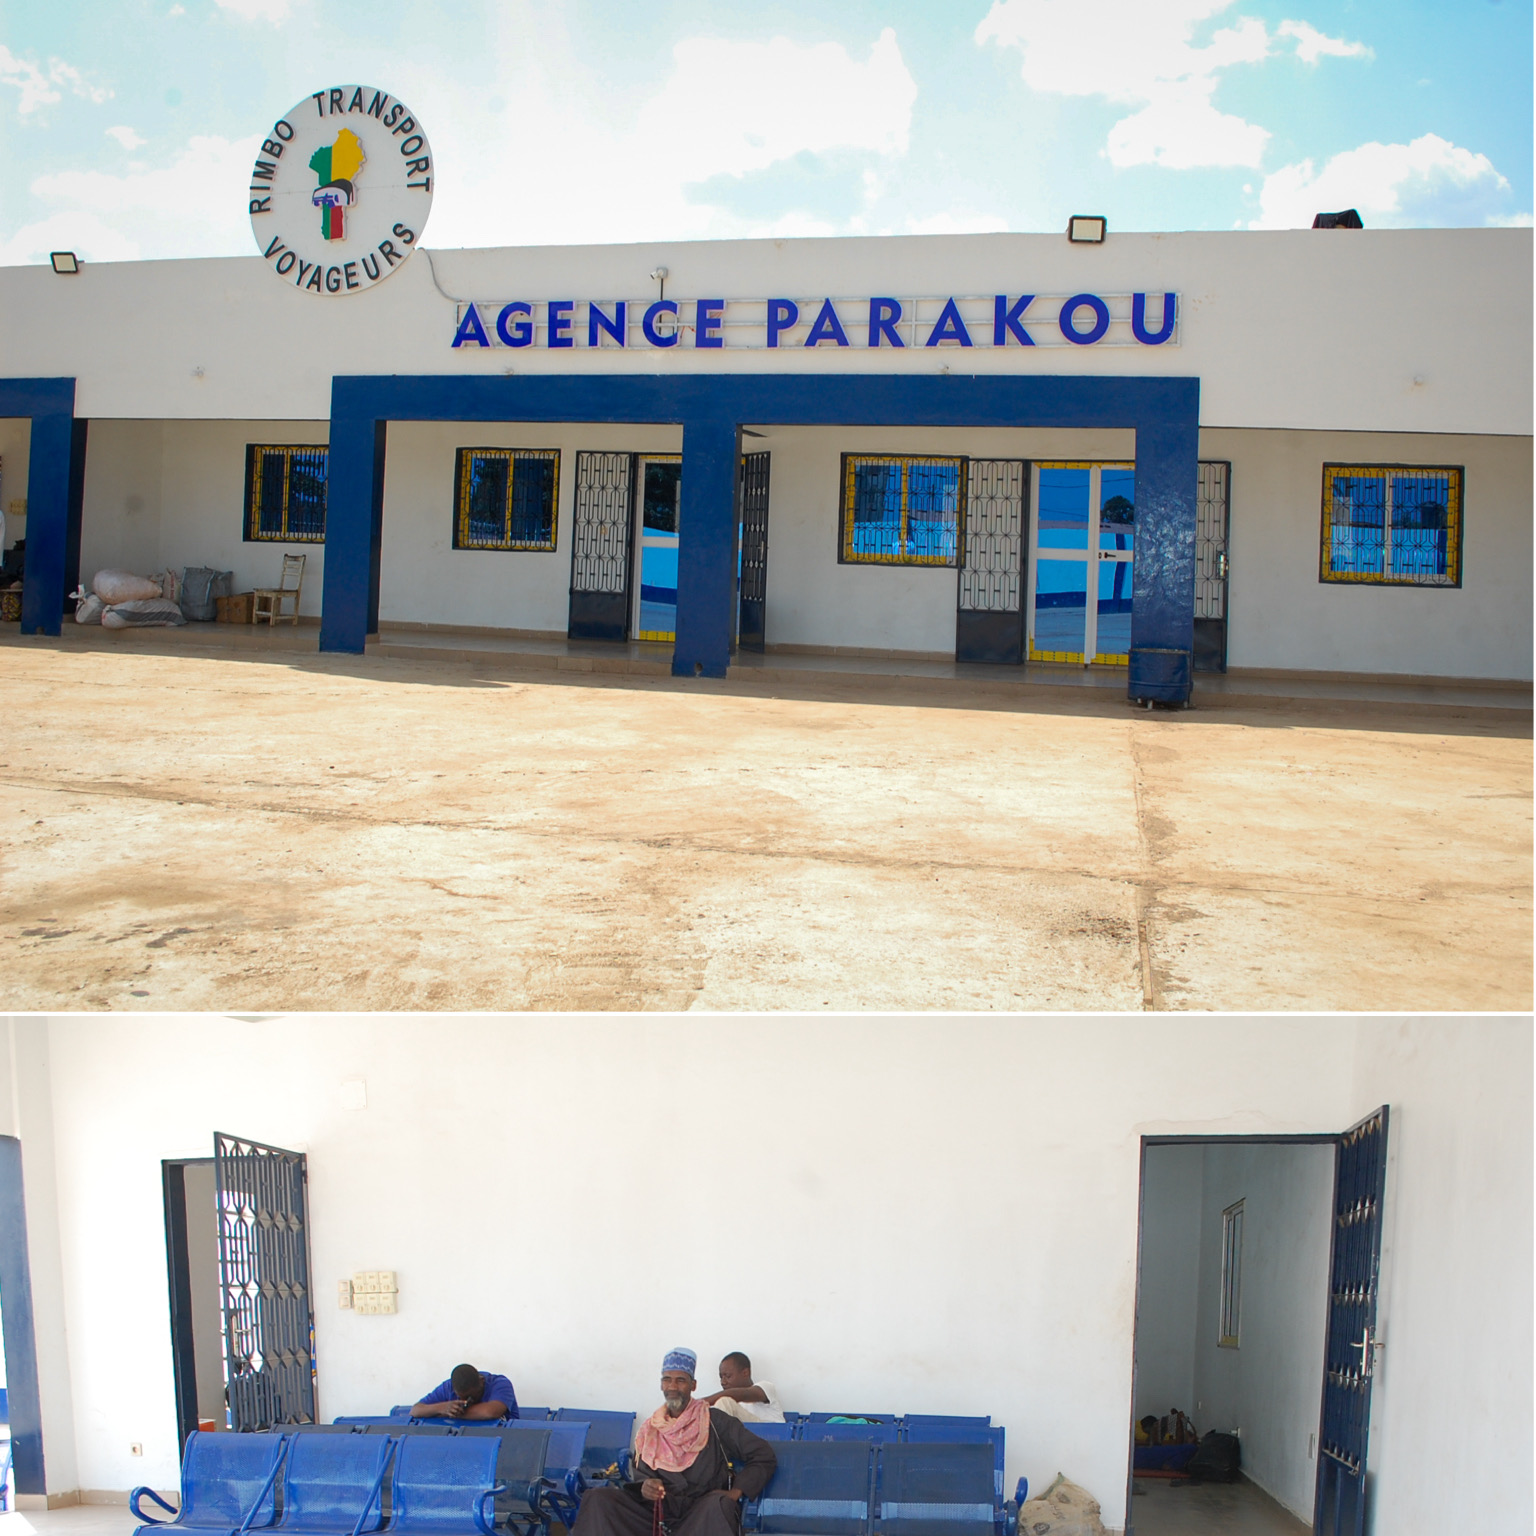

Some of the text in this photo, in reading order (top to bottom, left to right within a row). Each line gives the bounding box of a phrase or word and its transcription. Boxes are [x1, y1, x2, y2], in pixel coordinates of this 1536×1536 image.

[249, 86, 431, 215] RIMBO TRANSPORT
[264, 223, 415, 293] VOYAGEURS
[451, 292, 1177, 348] AGENCE PARAKOU
